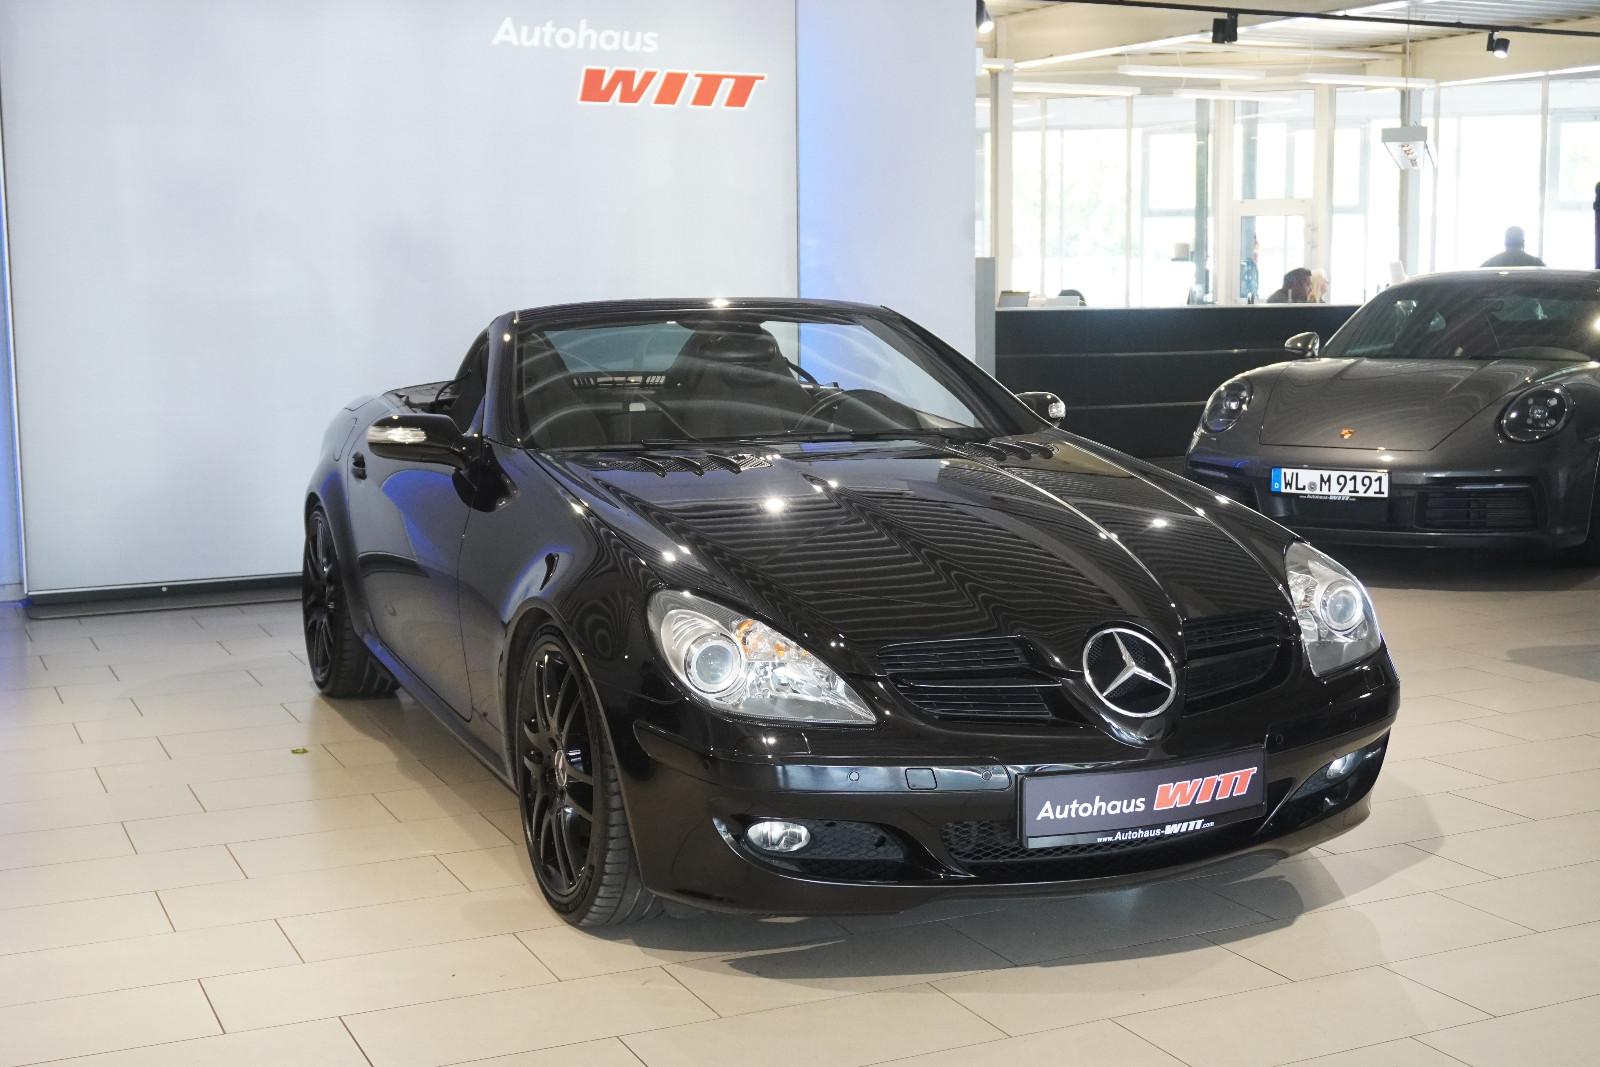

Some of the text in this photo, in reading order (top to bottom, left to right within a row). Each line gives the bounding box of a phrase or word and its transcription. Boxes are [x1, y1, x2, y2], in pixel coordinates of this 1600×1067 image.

[492, 17, 659, 52] Autohaus
[578, 66, 768, 110] WITT
[1283, 471, 1385, 495] WL M 9191
[1036, 767, 1257, 821] Autohaus WITT
[1097, 819, 1215, 842] www.Autohaus-WITT.com
